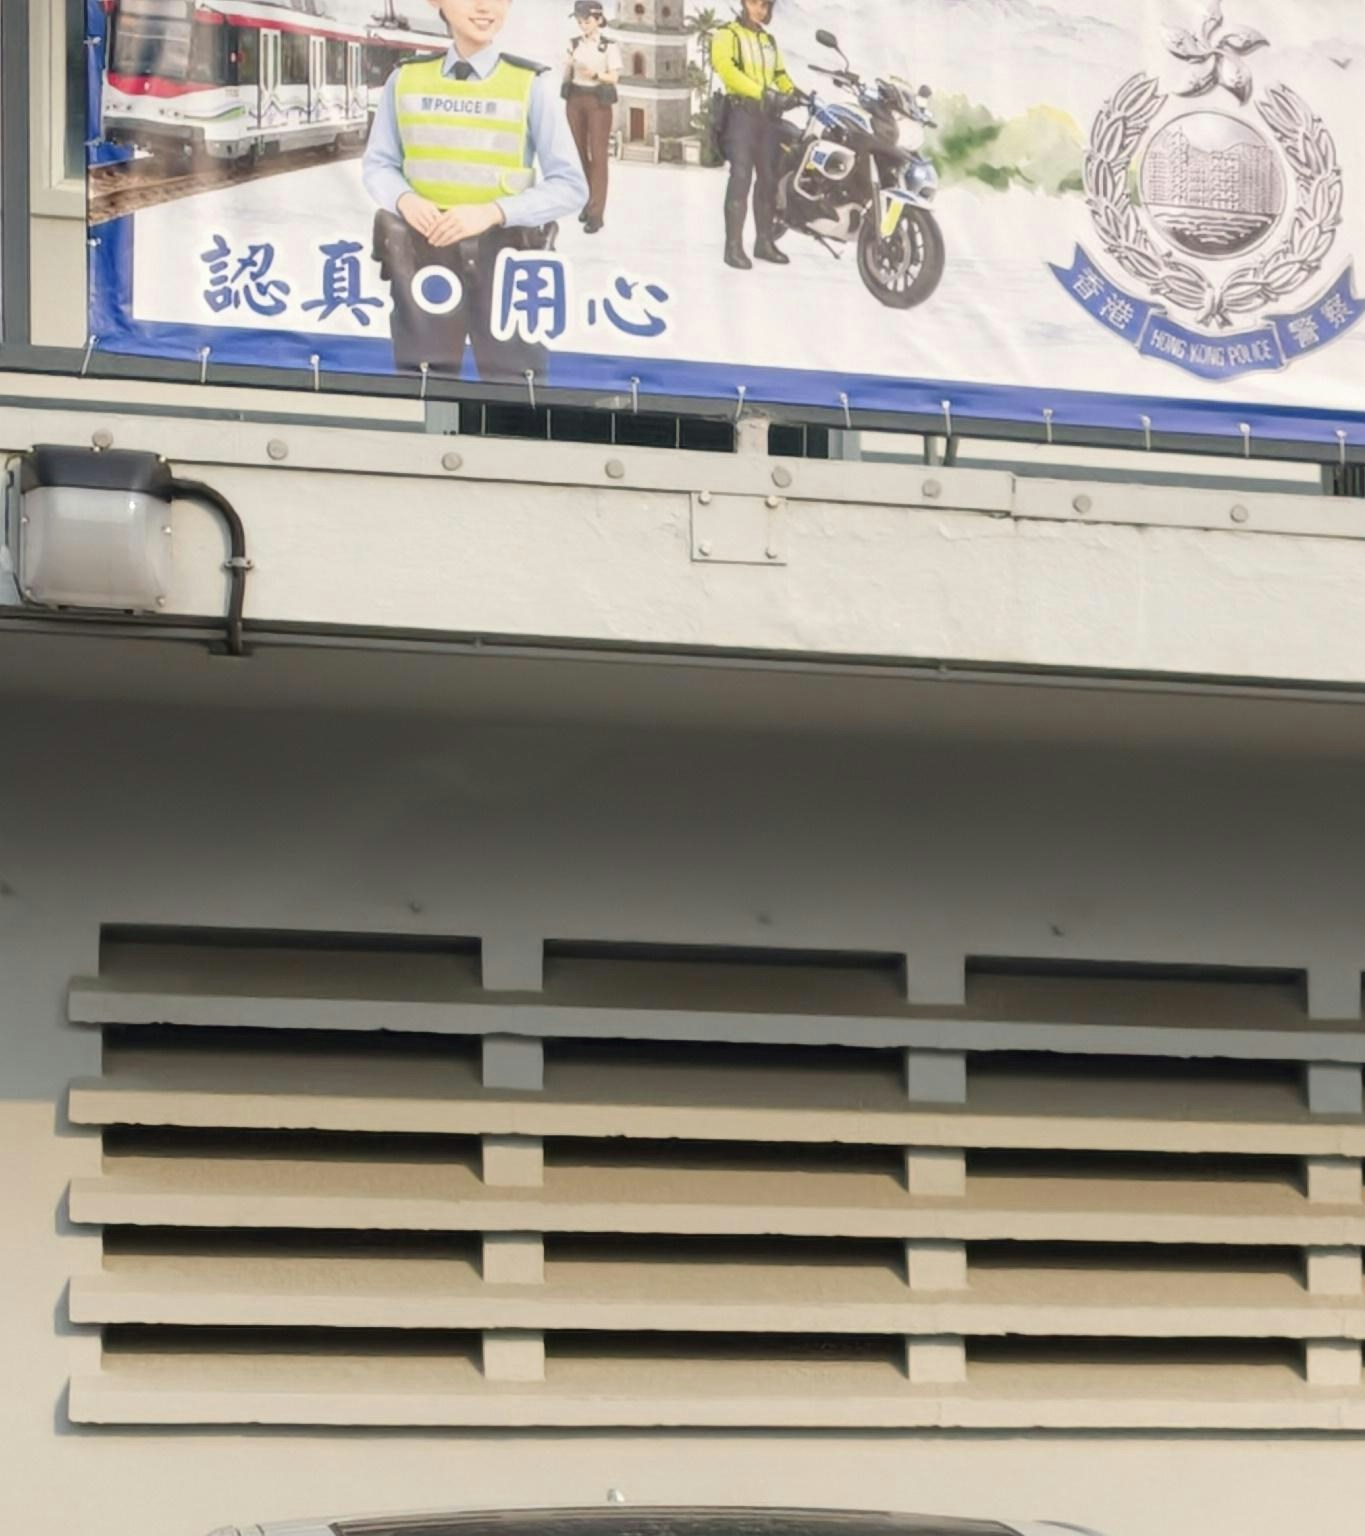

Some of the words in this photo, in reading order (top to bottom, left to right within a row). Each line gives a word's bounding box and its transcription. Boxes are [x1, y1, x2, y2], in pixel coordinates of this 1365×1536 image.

[434, 99, 481, 114] POLICE
[201, 235, 384, 326] 認真
[501, 257, 668, 339] 用心
[1072, 267, 1134, 330] 香港
[1151, 329, 1186, 358] HONG
[1188, 341, 1225, 366] KONG
[1228, 338, 1273, 366] POLICE
[1288, 293, 1354, 348] 警察
